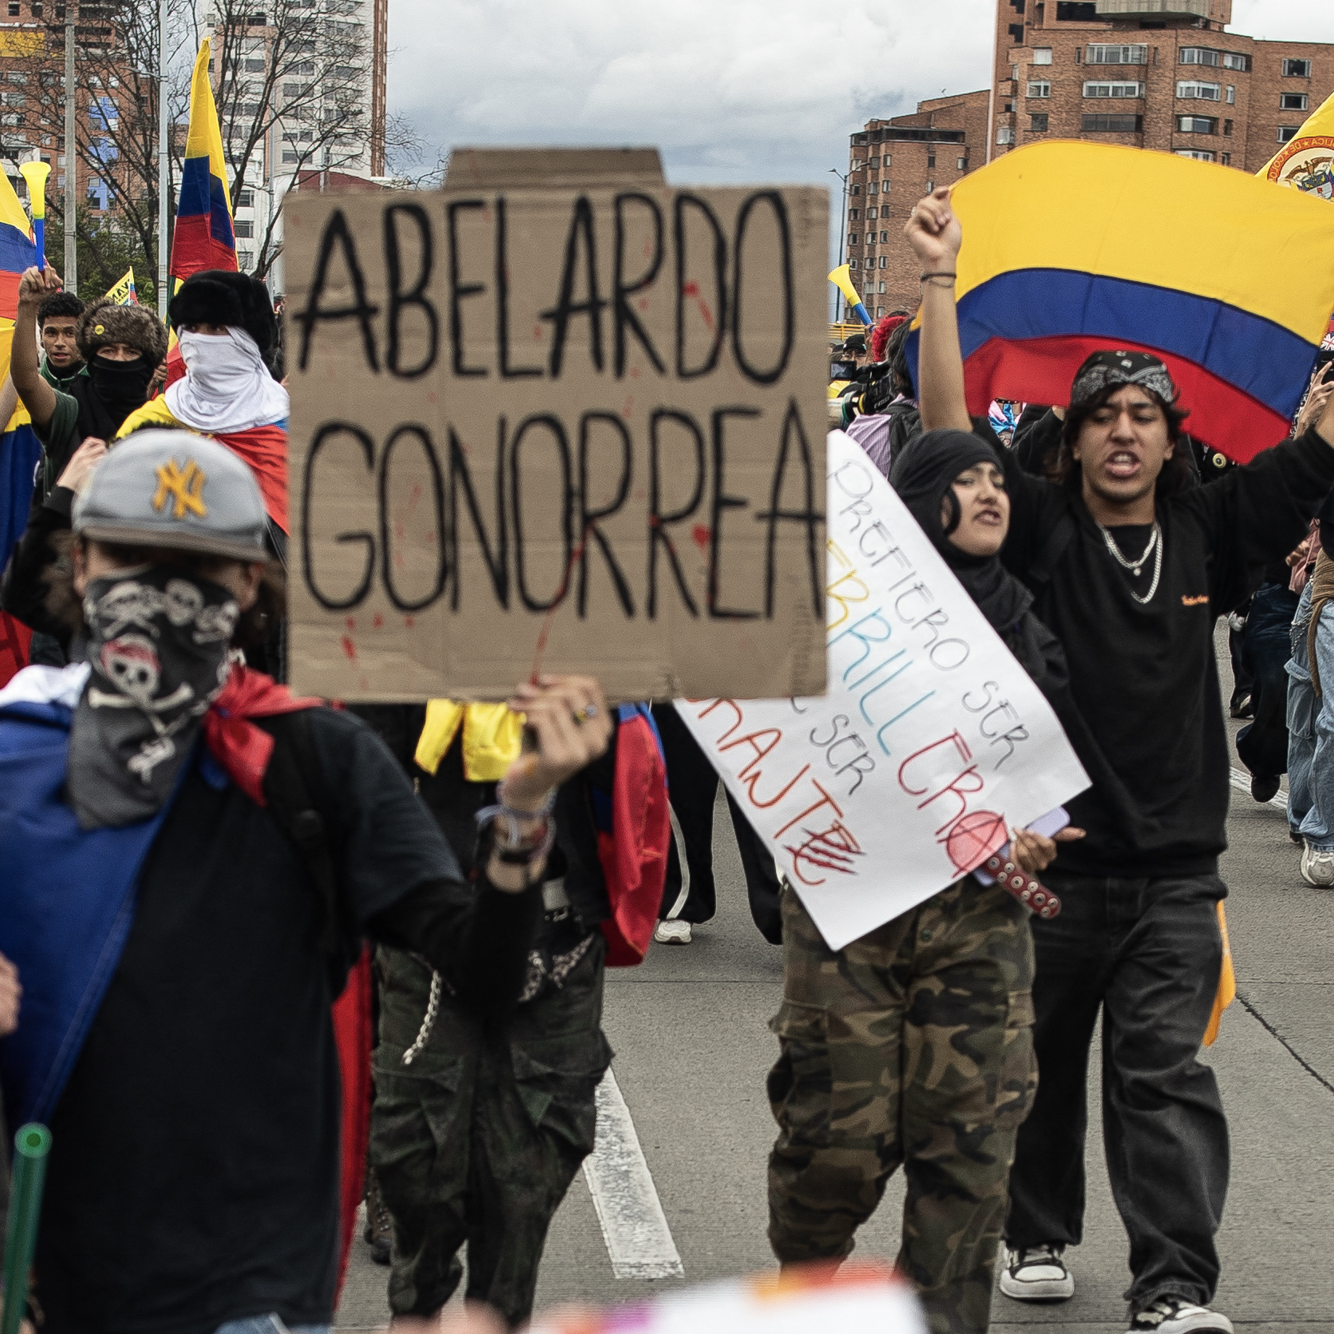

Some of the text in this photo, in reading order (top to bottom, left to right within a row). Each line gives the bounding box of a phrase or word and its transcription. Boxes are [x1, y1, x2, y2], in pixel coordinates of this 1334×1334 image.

[293, 189, 796, 386] ABELARDO
[302, 398, 827, 622] GONORREA
[962, 680, 1030, 772] SER
